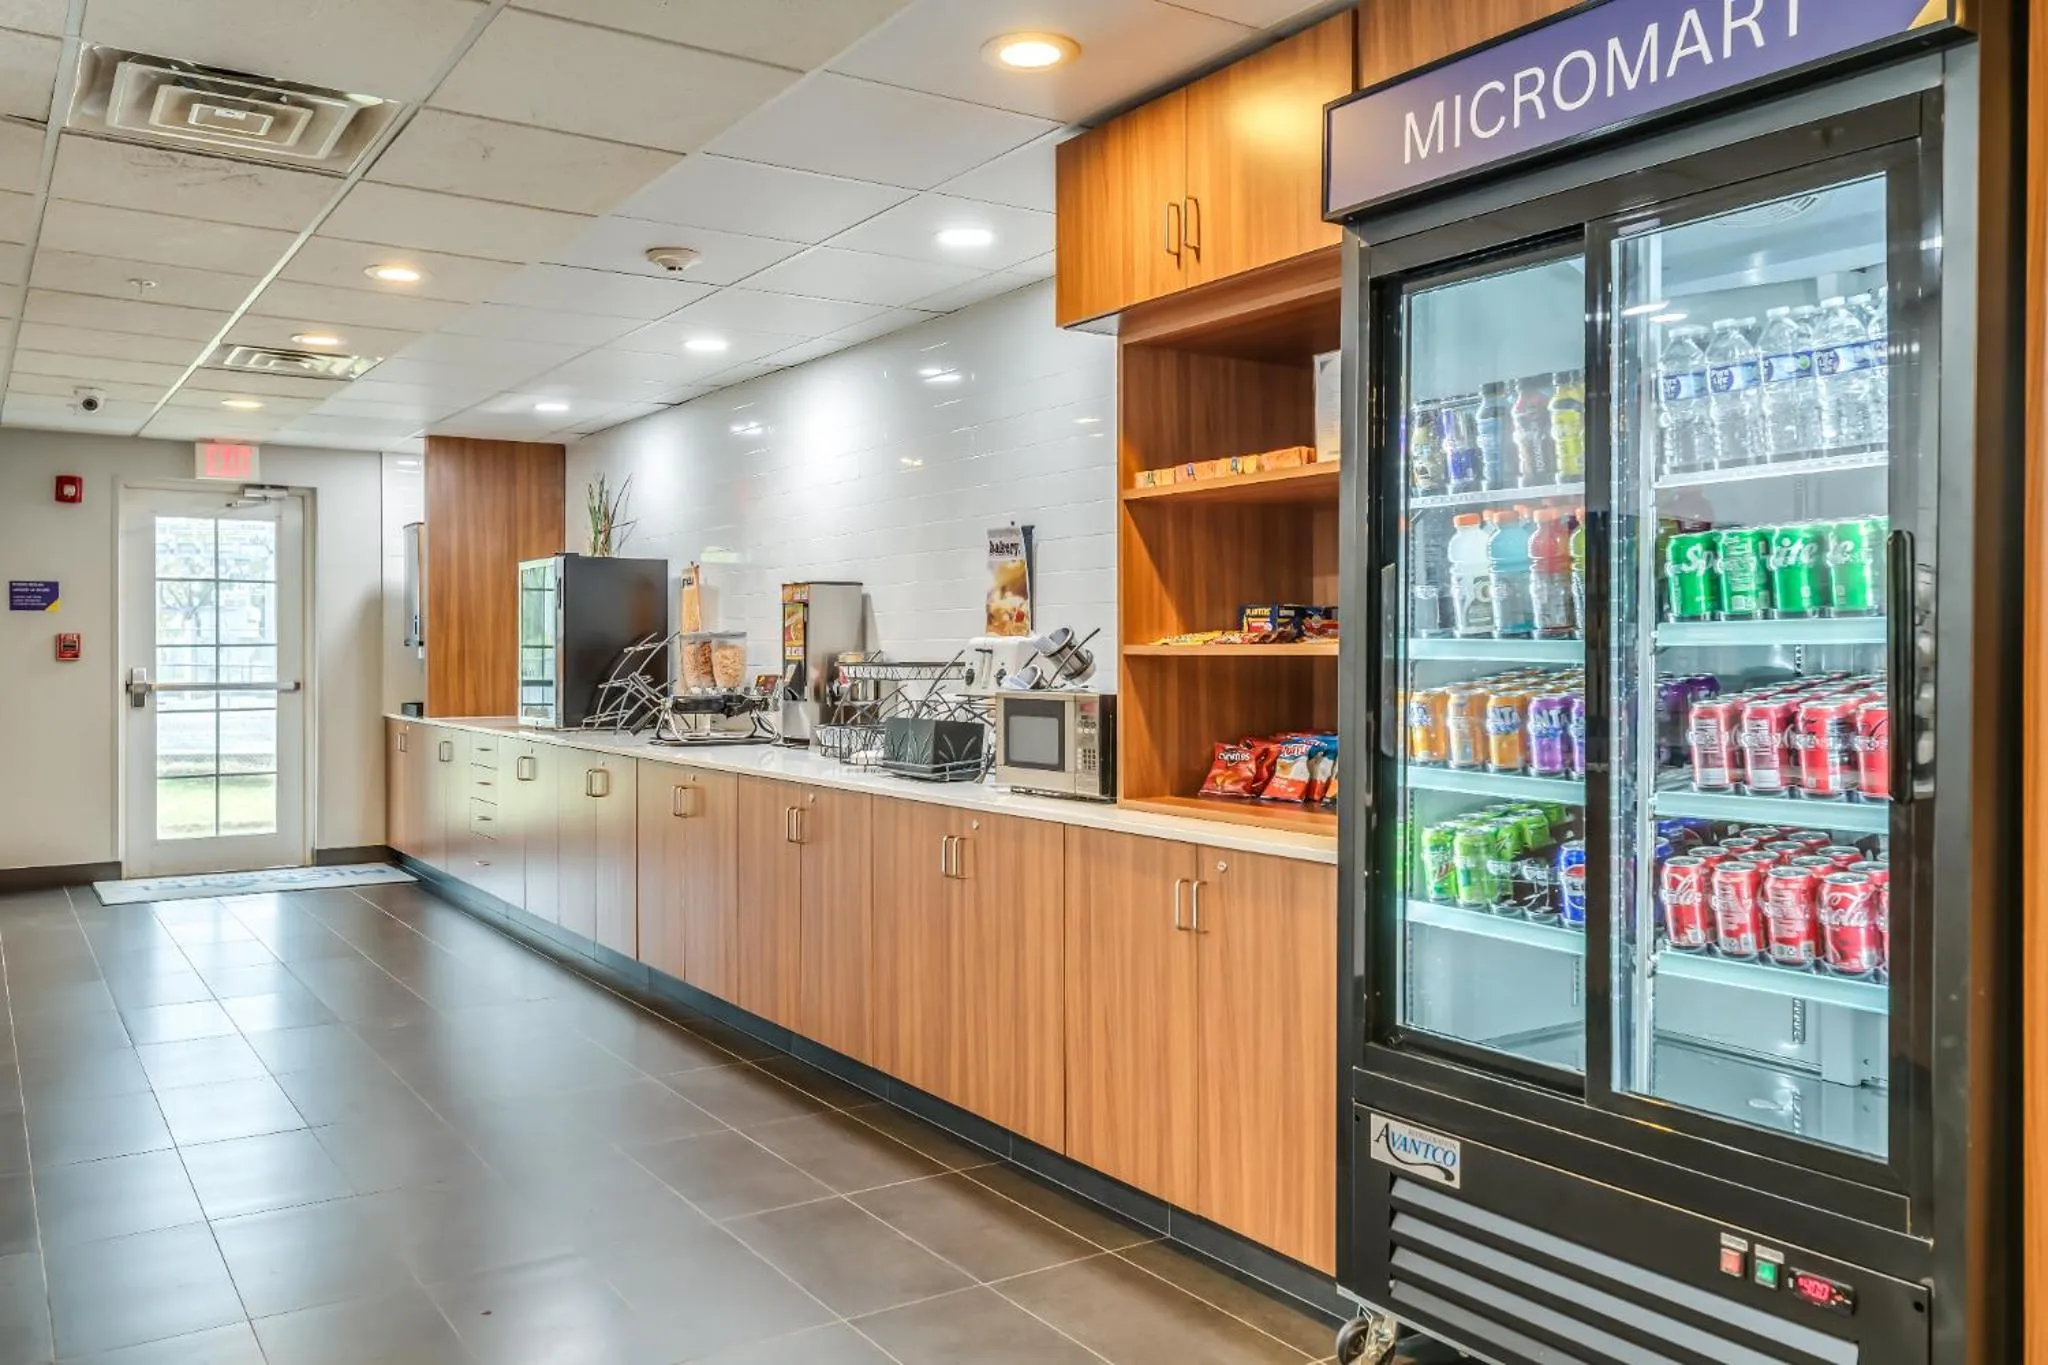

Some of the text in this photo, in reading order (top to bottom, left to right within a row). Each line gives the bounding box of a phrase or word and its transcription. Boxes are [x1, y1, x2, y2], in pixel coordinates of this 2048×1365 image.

[1403, 0, 1801, 165] MICROMART
[204, 444, 252, 478] EXIT
[1373, 1122, 1457, 1170] AVANTCO
